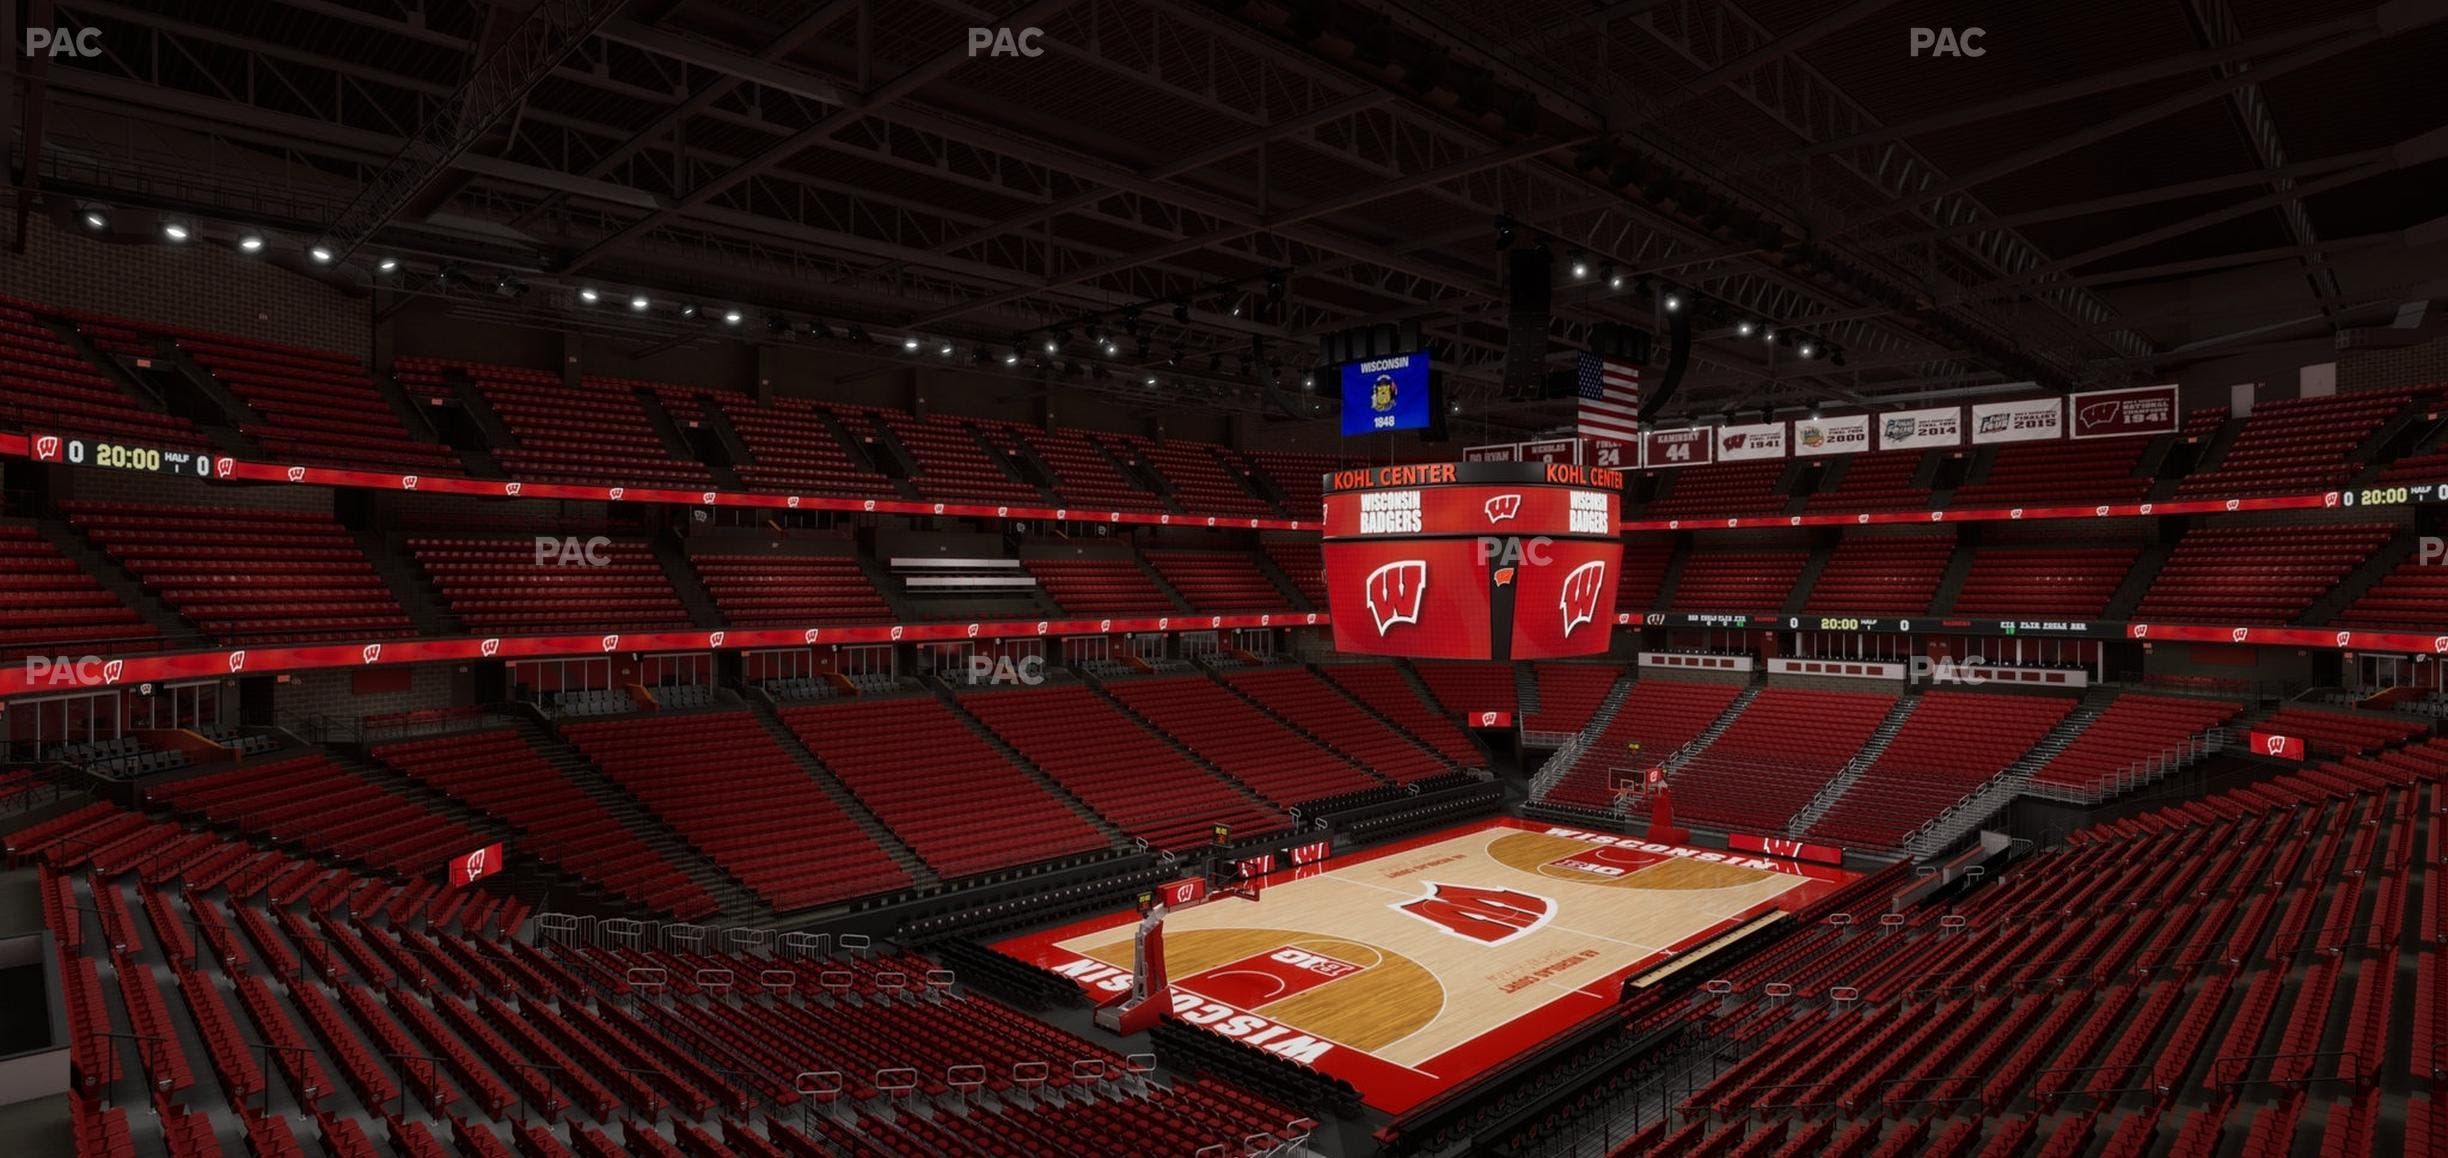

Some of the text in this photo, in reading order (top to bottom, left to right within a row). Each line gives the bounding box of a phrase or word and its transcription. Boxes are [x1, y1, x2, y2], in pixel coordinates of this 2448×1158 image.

[1361, 356, 1409, 374] WISCONSIN
[1374, 415, 1395, 428] 1848
[2014, 418, 2056, 429] 2015
[2122, 411, 2168, 424] 1941
[1826, 433, 1865, 443] 2000
[1917, 426, 1957, 436] 2014
[68, 440, 84, 463] 0
[1665, 442, 1690, 461] 44
[1750, 440, 1779, 449] 1941
[96, 444, 160, 470] 20:00
[164, 452, 190, 463] HALF
[197, 456, 209, 476] 0
[1597, 449, 1620, 466] 24
[1334, 464, 1457, 490] KOHL CENTER
[1546, 463, 1623, 490] KOHL CENTER
[1360, 490, 1421, 513] WISCONSIN
[2343, 491, 2354, 507] 0
[2361, 487, 2408, 506] 20:00
[1484, 494, 1522, 524] W
[1360, 509, 1422, 534] BADGERS
[1569, 510, 1609, 534] BADGERS
[1366, 560, 1427, 637] W
[1559, 560, 1606, 639] W
[1789, 616, 1799, 629] 0
[1820, 617, 1858, 631] 20:00
[1899, 620, 1910, 632] 0
[1544, 827, 1773, 870] WISCONSIN
[1050, 958, 1335, 1065] WISCOSIN
